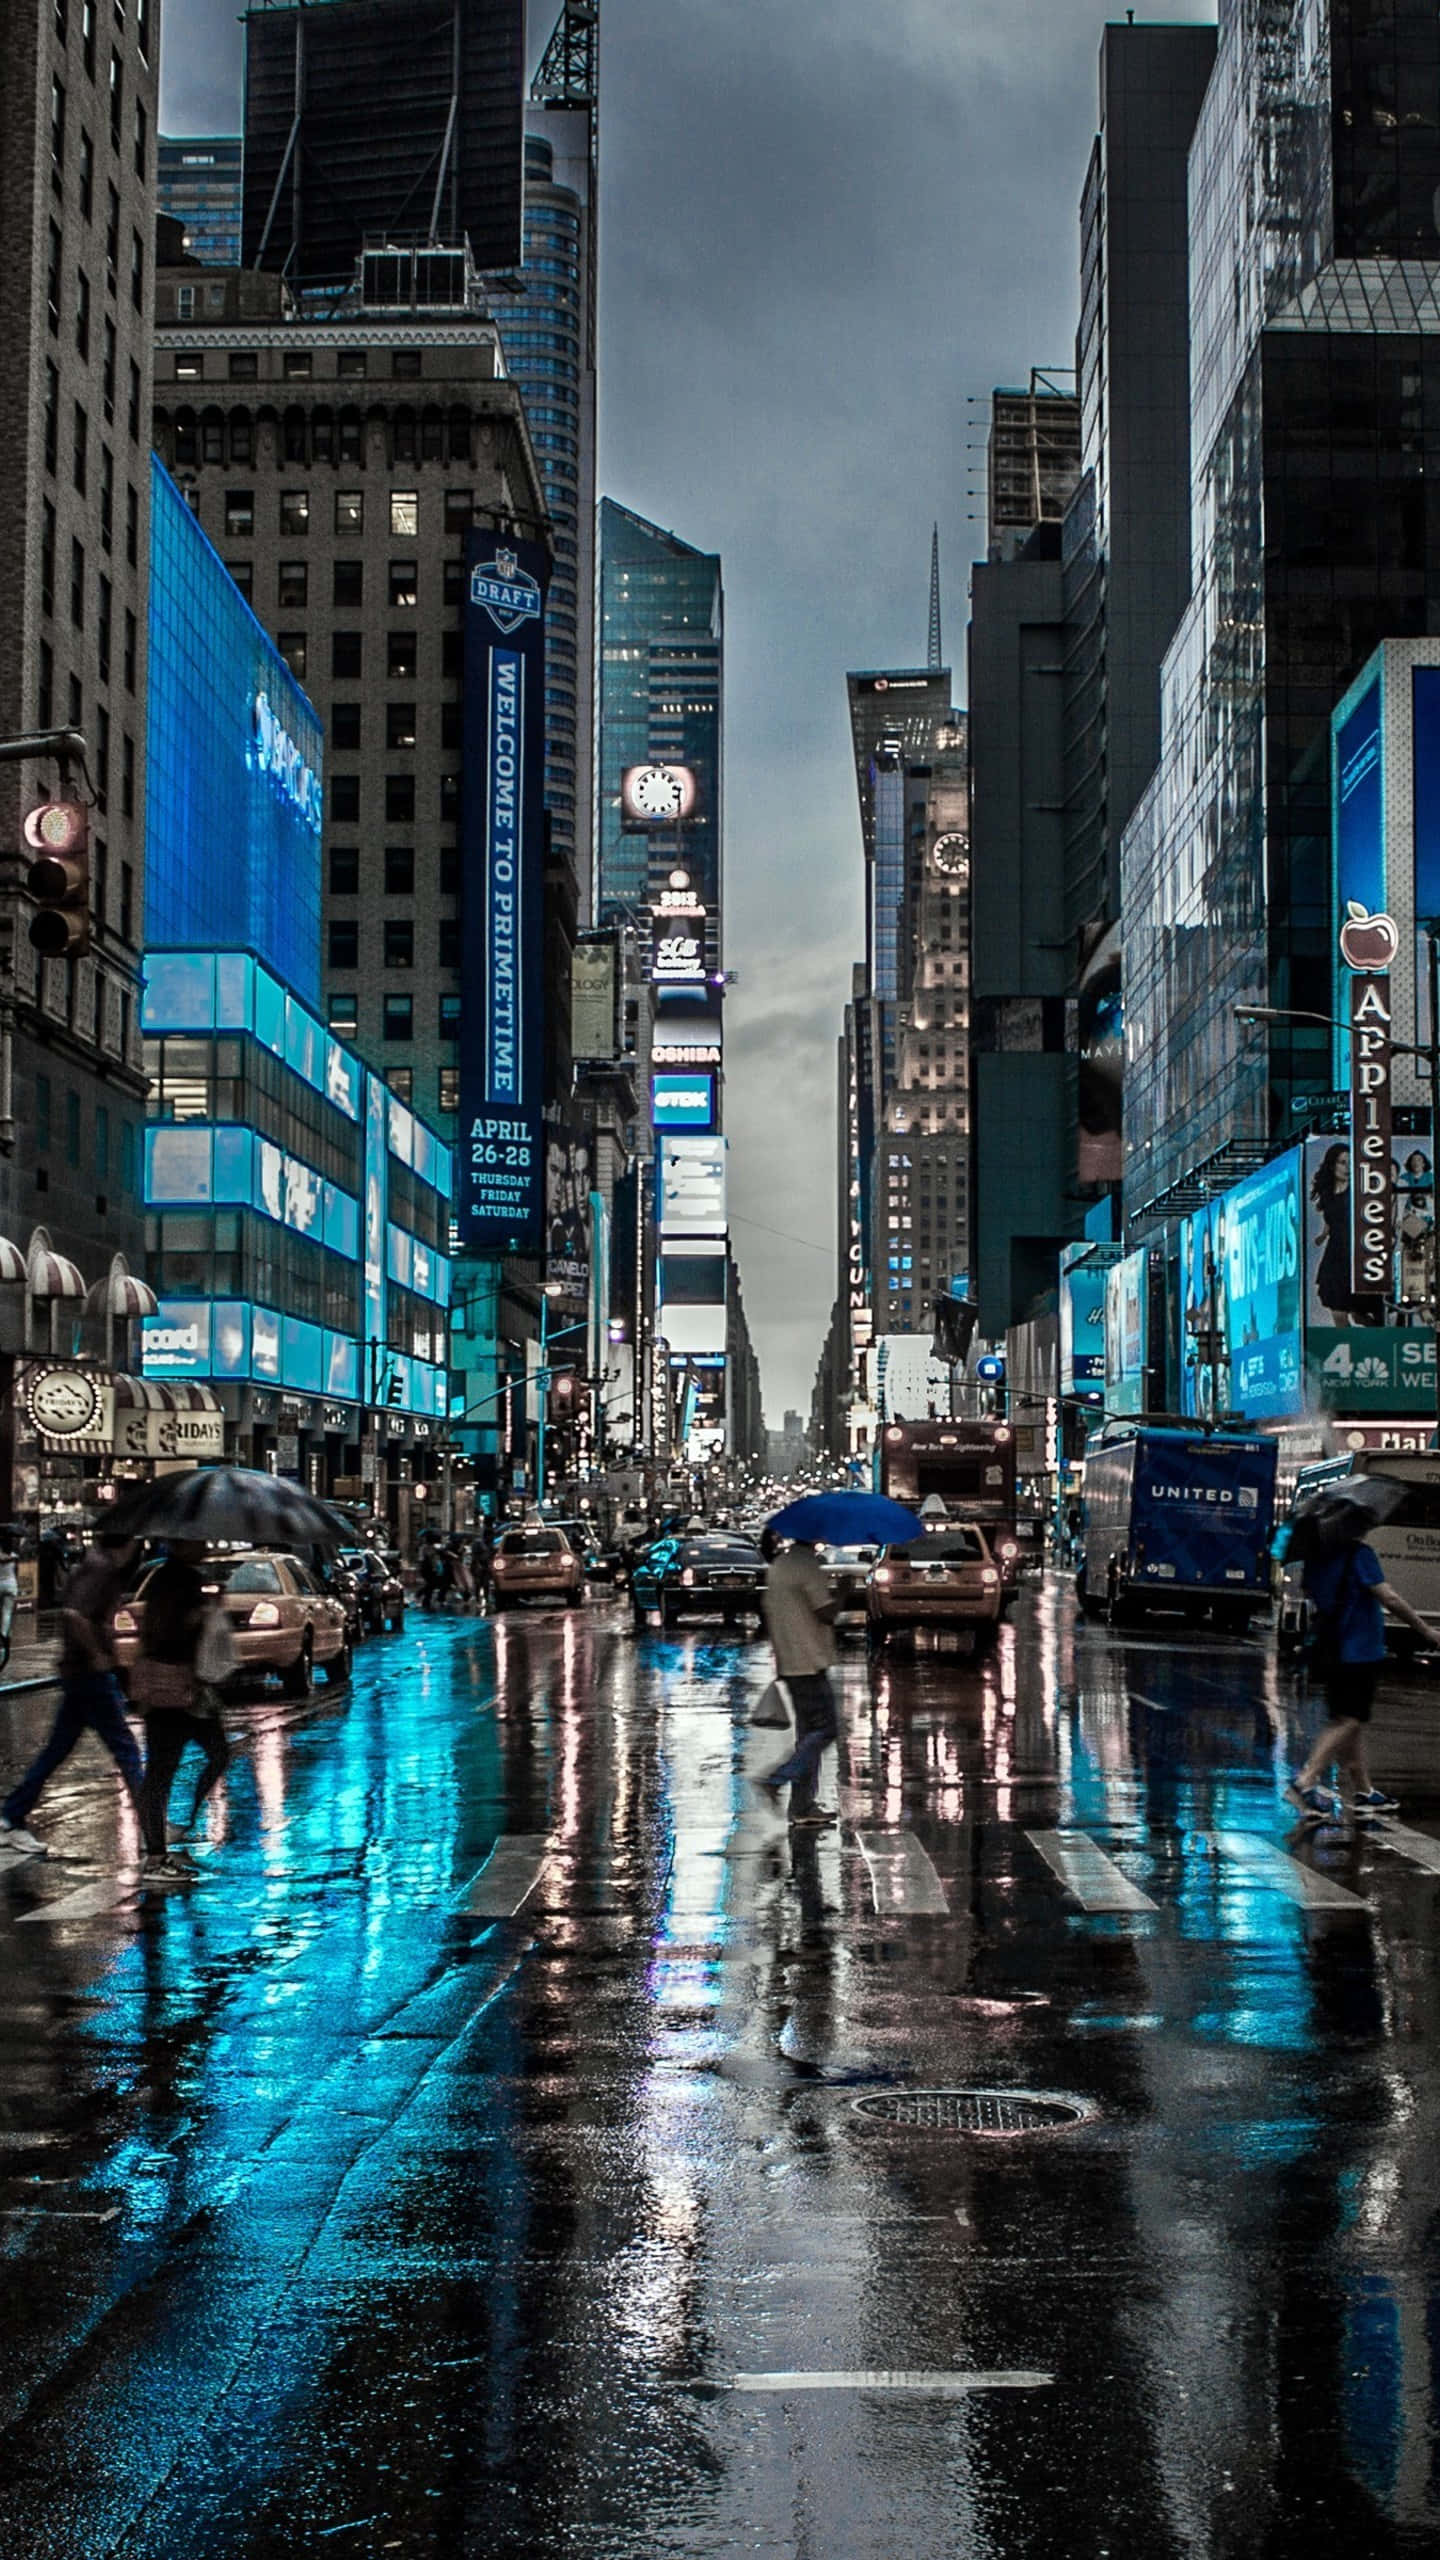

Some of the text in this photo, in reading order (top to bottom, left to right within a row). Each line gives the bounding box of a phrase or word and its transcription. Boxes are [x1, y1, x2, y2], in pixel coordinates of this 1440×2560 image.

[477, 580, 535, 608] DRAFT
[494, 662, 516, 1091] WELCOME TO PRIMETIME
[470, 1118, 532, 1142] APRIL
[1353, 983, 1391, 1282] Applebee's
[471, 1143, 531, 1167] 26-28
[470, 1172, 532, 1188] THURSDAY
[480, 1188, 522, 1203] FRIDAY
[471, 1203, 531, 1219] SATURDAY
[560, 1280, 585, 1298] OPEZ
[1322, 1343, 1354, 1378] 4
[1402, 1373, 1437, 1388] WE
[1151, 1485, 1233, 1502] UNITED
